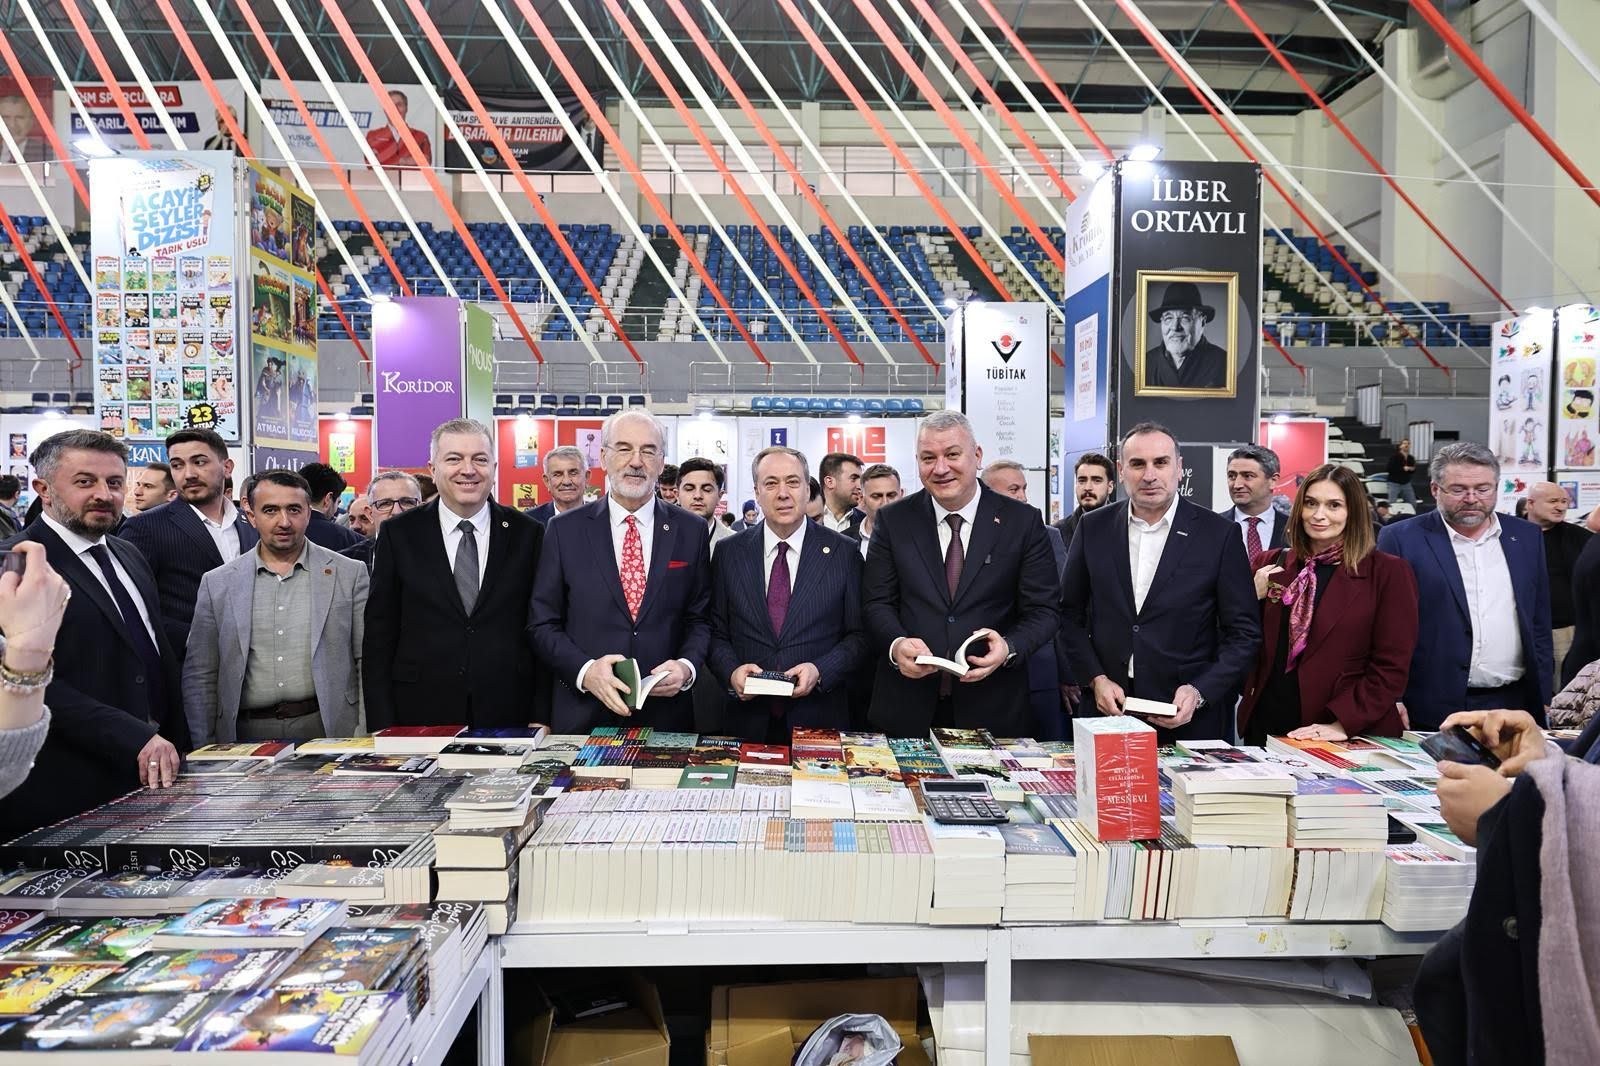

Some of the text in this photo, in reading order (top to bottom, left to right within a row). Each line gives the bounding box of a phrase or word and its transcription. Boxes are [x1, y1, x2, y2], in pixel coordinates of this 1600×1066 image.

[513, 127, 563, 142] DİLERİM
[1152, 174, 1231, 203] İLBER
[130, 186, 205, 214] ACAYİP
[132, 204, 205, 232] ŞEYLER
[1131, 209, 1247, 234] ORTAYLI
[138, 220, 200, 251] DİZİSİ
[155, 237, 208, 257] TARIK USLU
[986, 366, 1026, 380] TÜBİTAK
[190, 406, 213, 423] 23
[256, 423, 286, 434] ATMACA
[1107, 792, 1148, 805] MESNEVİ
